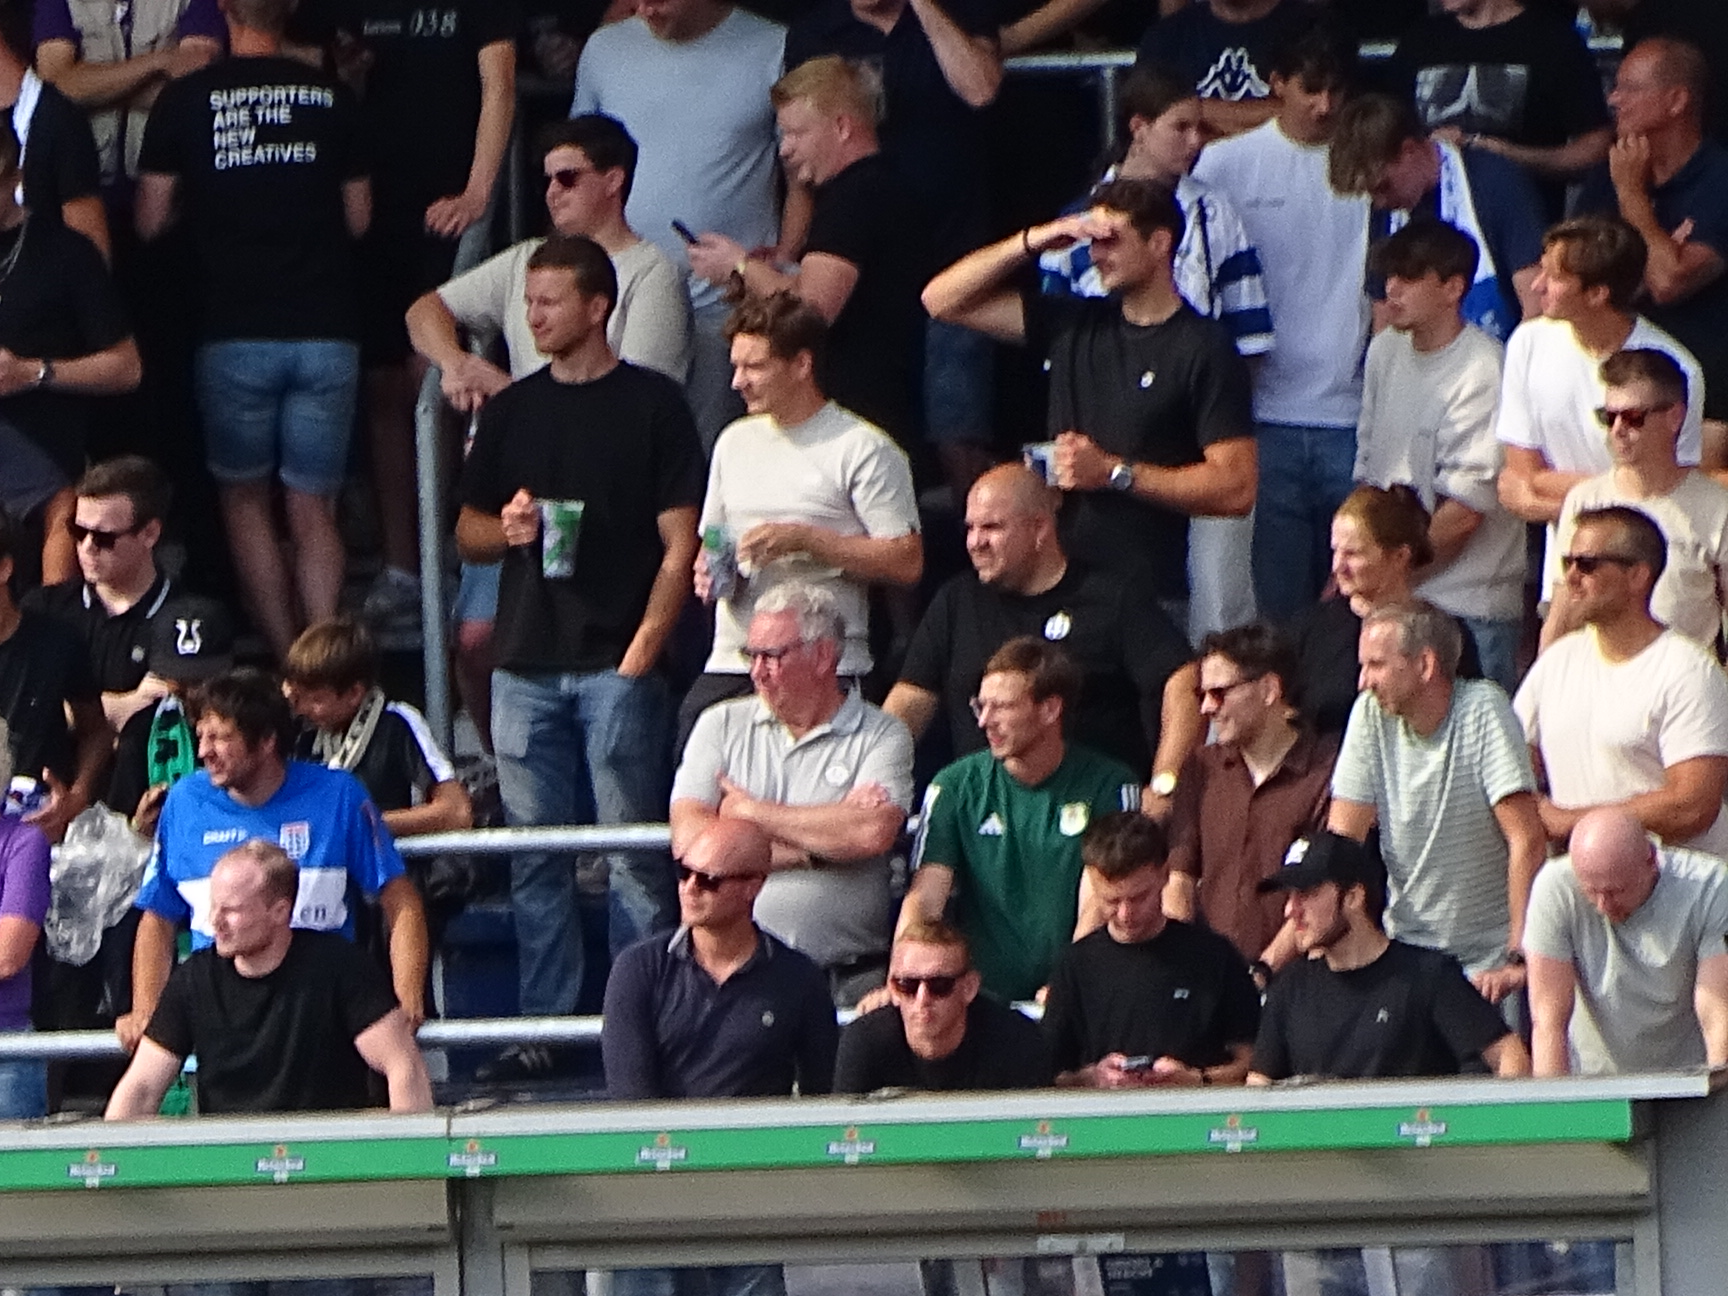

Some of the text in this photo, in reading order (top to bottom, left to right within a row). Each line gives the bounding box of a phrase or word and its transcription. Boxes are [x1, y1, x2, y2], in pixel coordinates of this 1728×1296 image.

[209, 86, 335, 111] SUPPORTERS
[213, 105, 292, 131] ARE THE
[213, 126, 256, 150] NEW
[214, 142, 317, 170] CREATIVES
